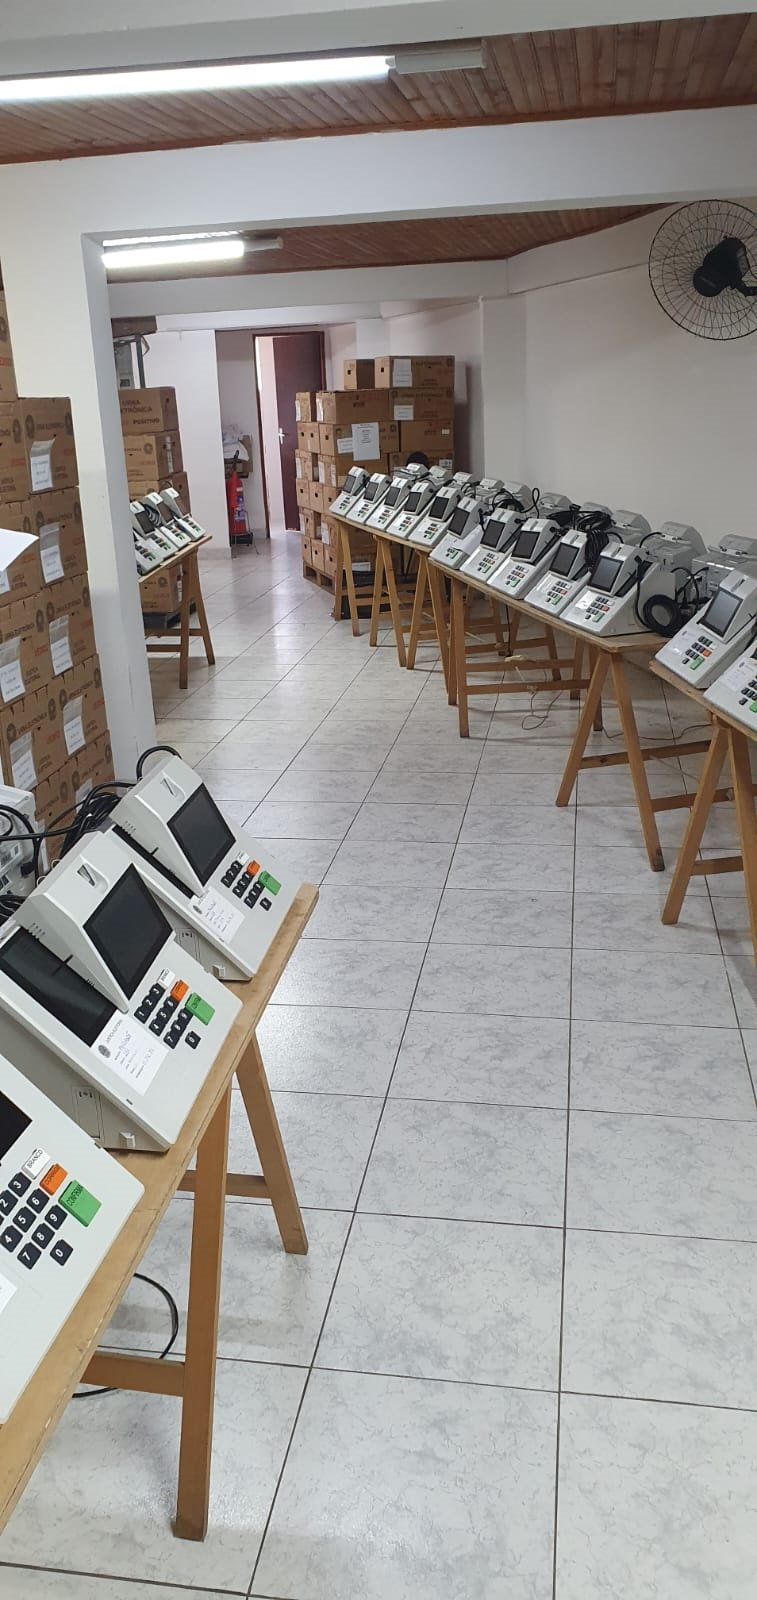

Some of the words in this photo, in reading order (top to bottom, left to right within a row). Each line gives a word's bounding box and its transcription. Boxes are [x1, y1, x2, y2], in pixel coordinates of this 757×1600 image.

[0, 1198, 8, 1208] 2
[13, 1181, 22, 1189] 3
[26, 1149, 43, 1169] BRANCO
[5, 1234, 12, 1243] 4
[18, 1215, 26, 1224] 5
[31, 1197, 40, 1205] 6
[22, 1251, 31, 1261] 7
[36, 1232, 45, 1241] 8
[49, 1213, 58, 1222] 9
[55, 1249, 64, 1258] 0
